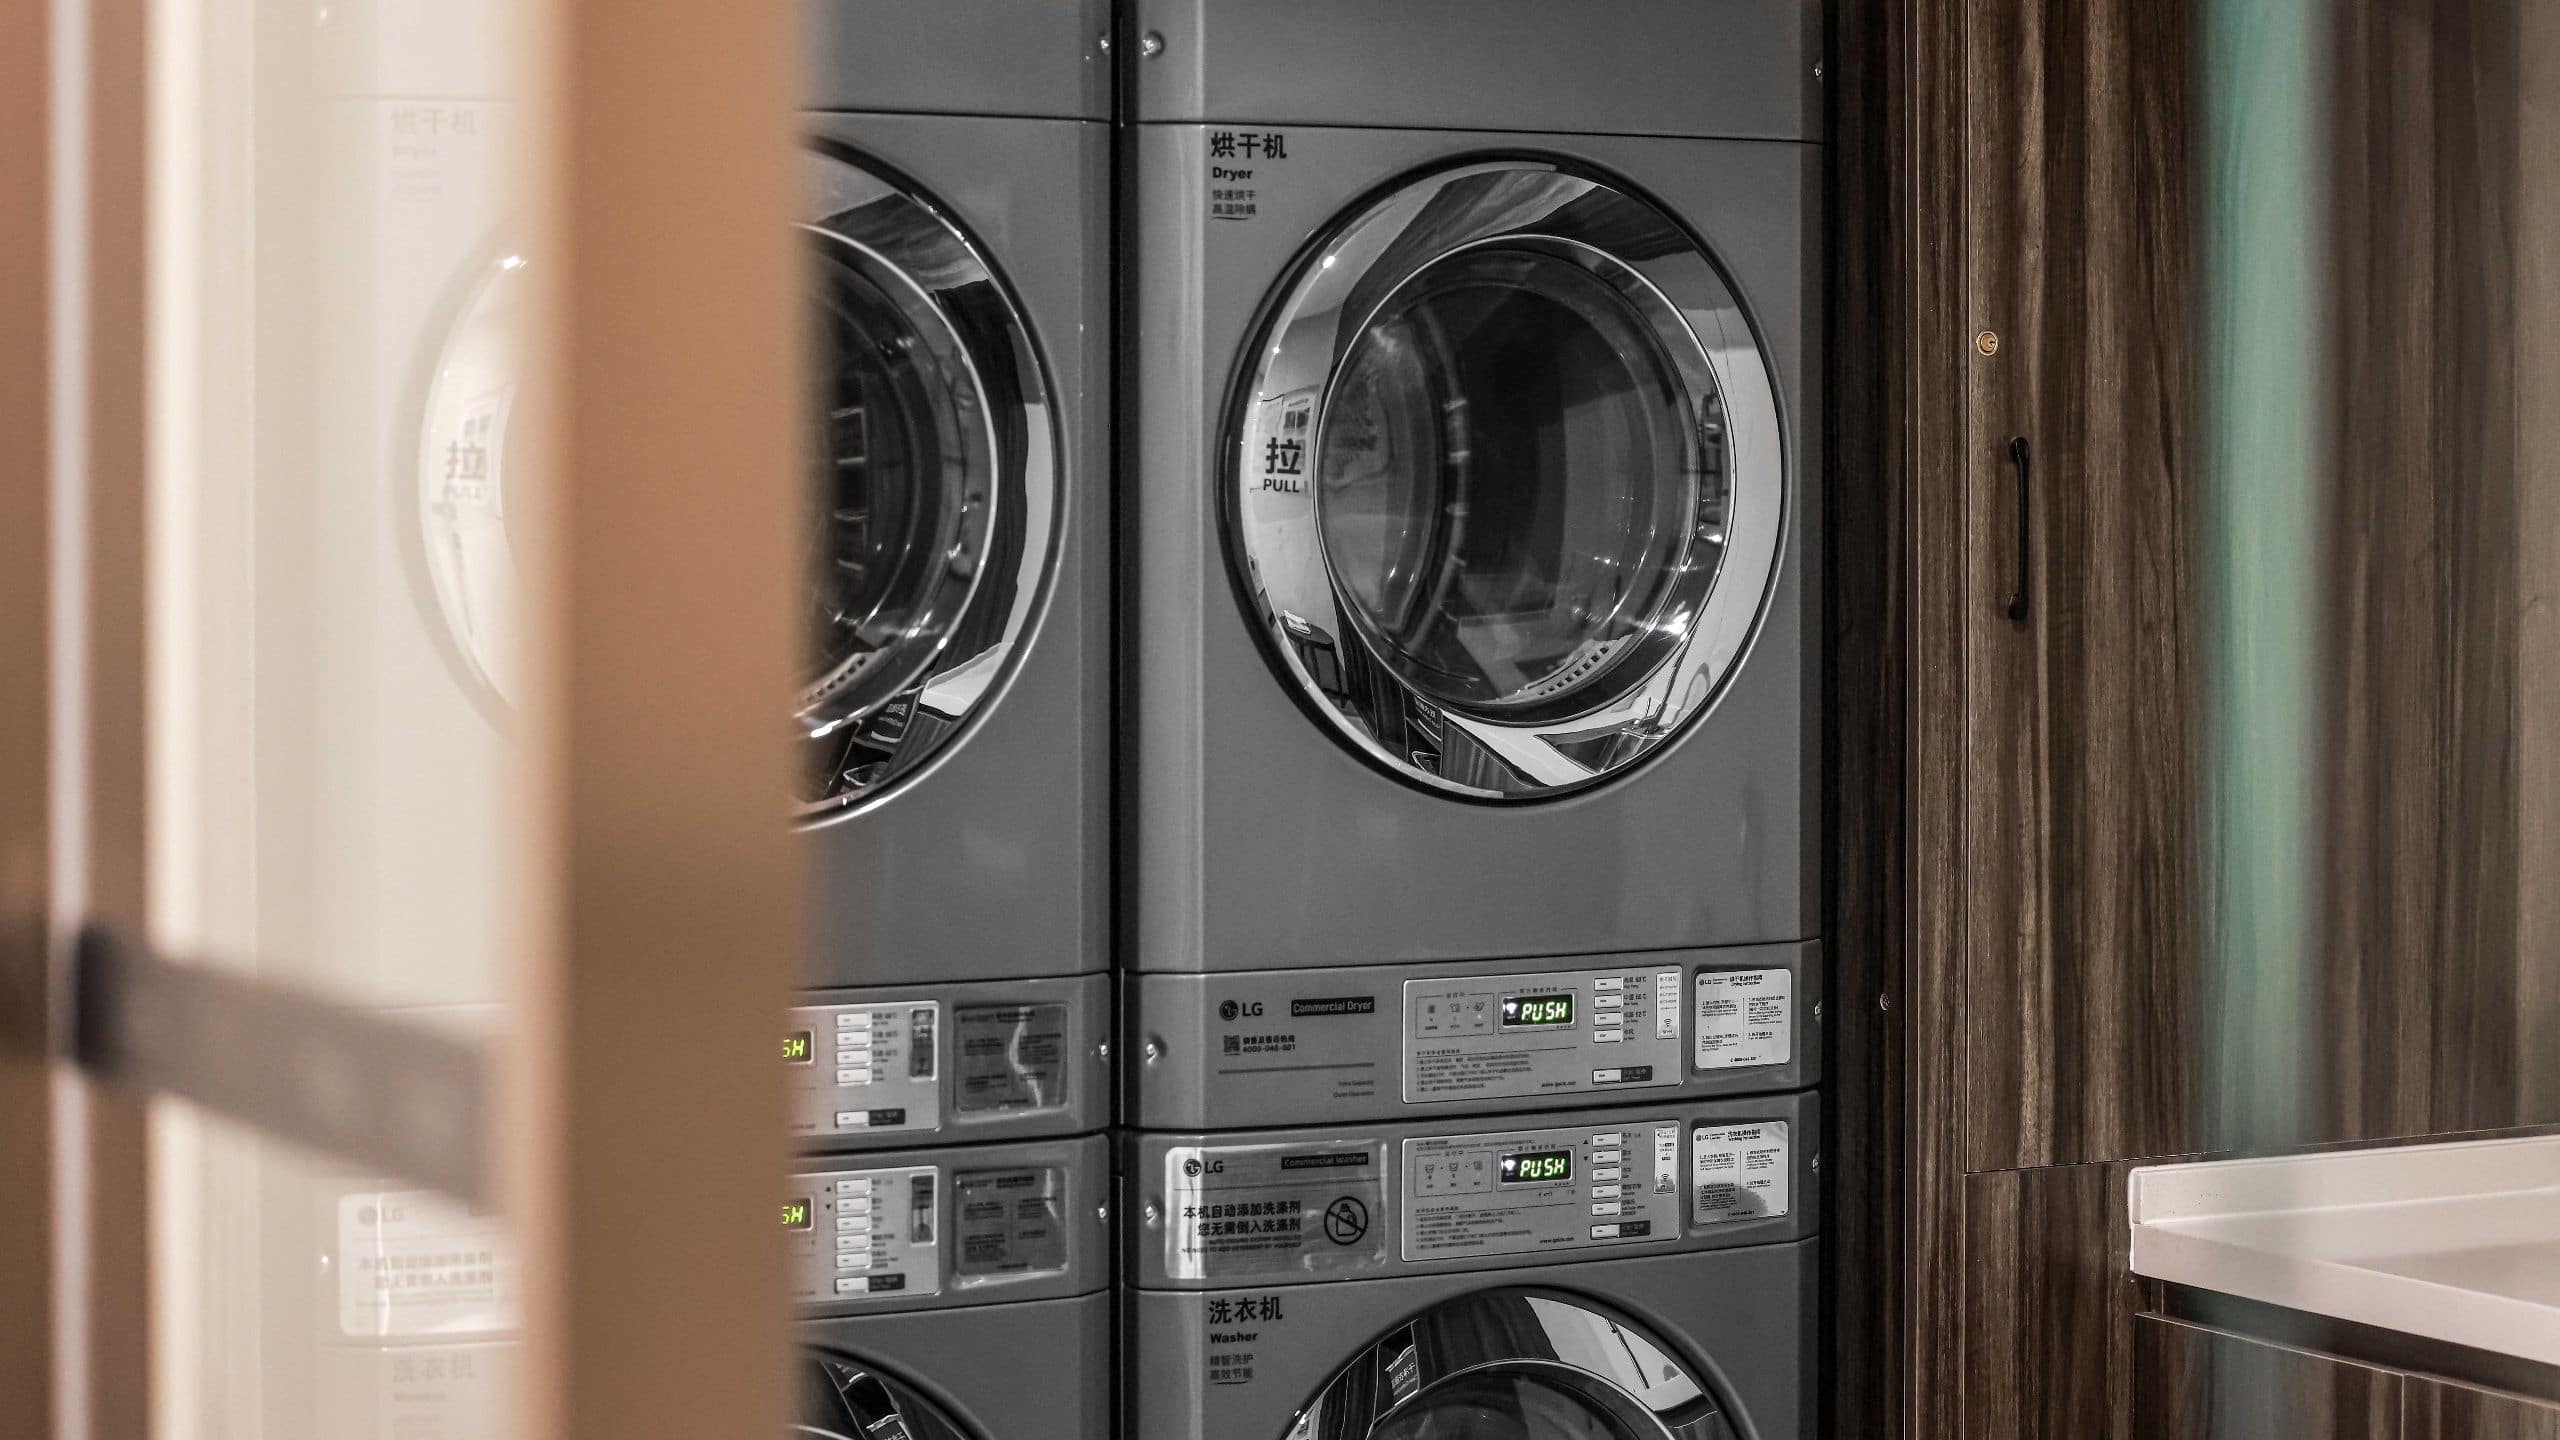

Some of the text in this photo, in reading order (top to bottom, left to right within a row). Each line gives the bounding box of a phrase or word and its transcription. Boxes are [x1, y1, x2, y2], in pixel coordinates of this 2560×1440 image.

[1211, 132, 1287, 159] 烘干机
[1212, 167, 1253, 181] Dryer
[1265, 437, 1301, 474] 拉
[1263, 478, 1300, 493] PULL
[1242, 1002, 1263, 1017] LG
[1293, 1000, 1372, 1014] Commercial Dryer
[1521, 1001, 1567, 1021] PUSH
[1204, 1160, 1224, 1174] LG
[1519, 1158, 1565, 1178] PUSH
[1183, 1200, 1301, 1219] 本机自动添加洗涤剂
[1208, 1296, 1283, 1325] 洗衣机
[1210, 1330, 1258, 1344] Washer
